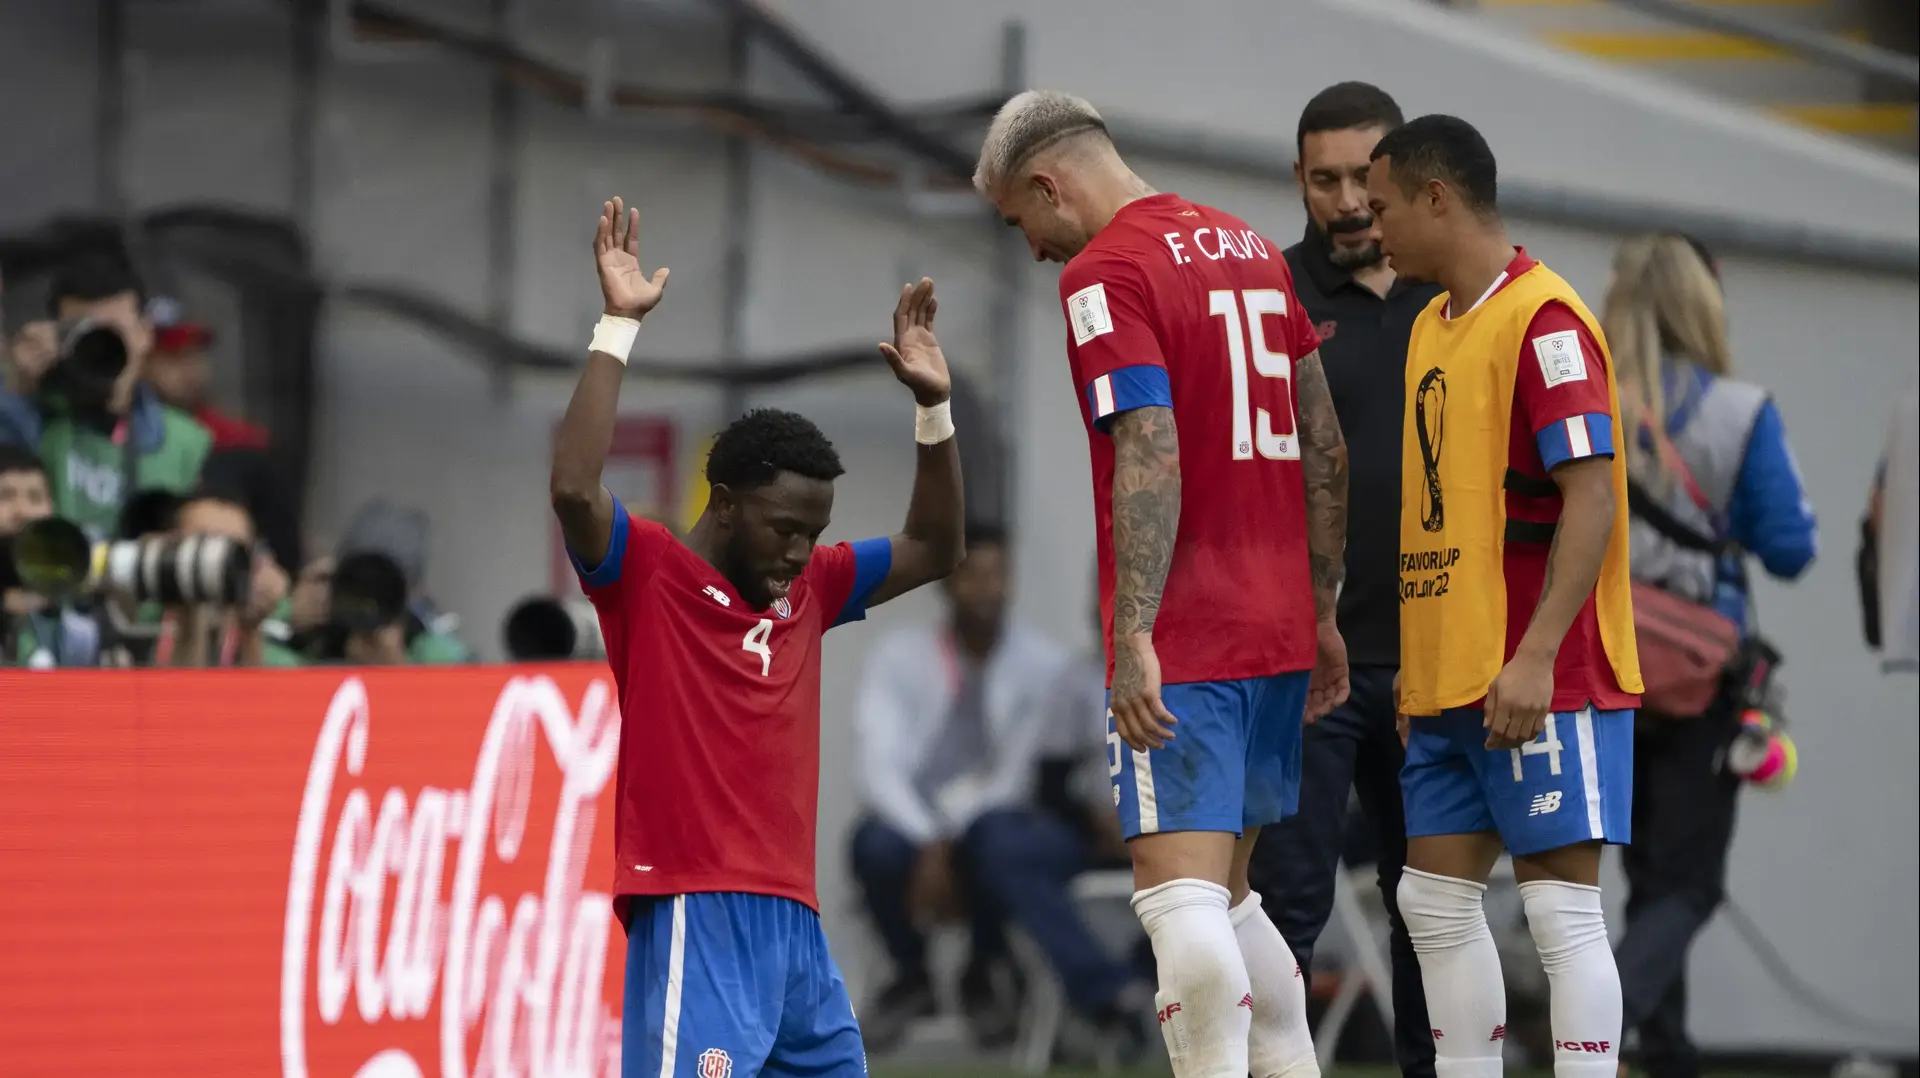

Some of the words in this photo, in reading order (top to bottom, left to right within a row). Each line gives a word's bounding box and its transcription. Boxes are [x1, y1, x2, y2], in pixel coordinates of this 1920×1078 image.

[1164, 232, 1191, 265] F.
[1194, 227, 1269, 261] CALVO
[1209, 289, 1300, 461] 15
[742, 618, 772, 677] 4
[1106, 707, 1122, 778] 5
[1158, 1001, 1182, 1024] RF
